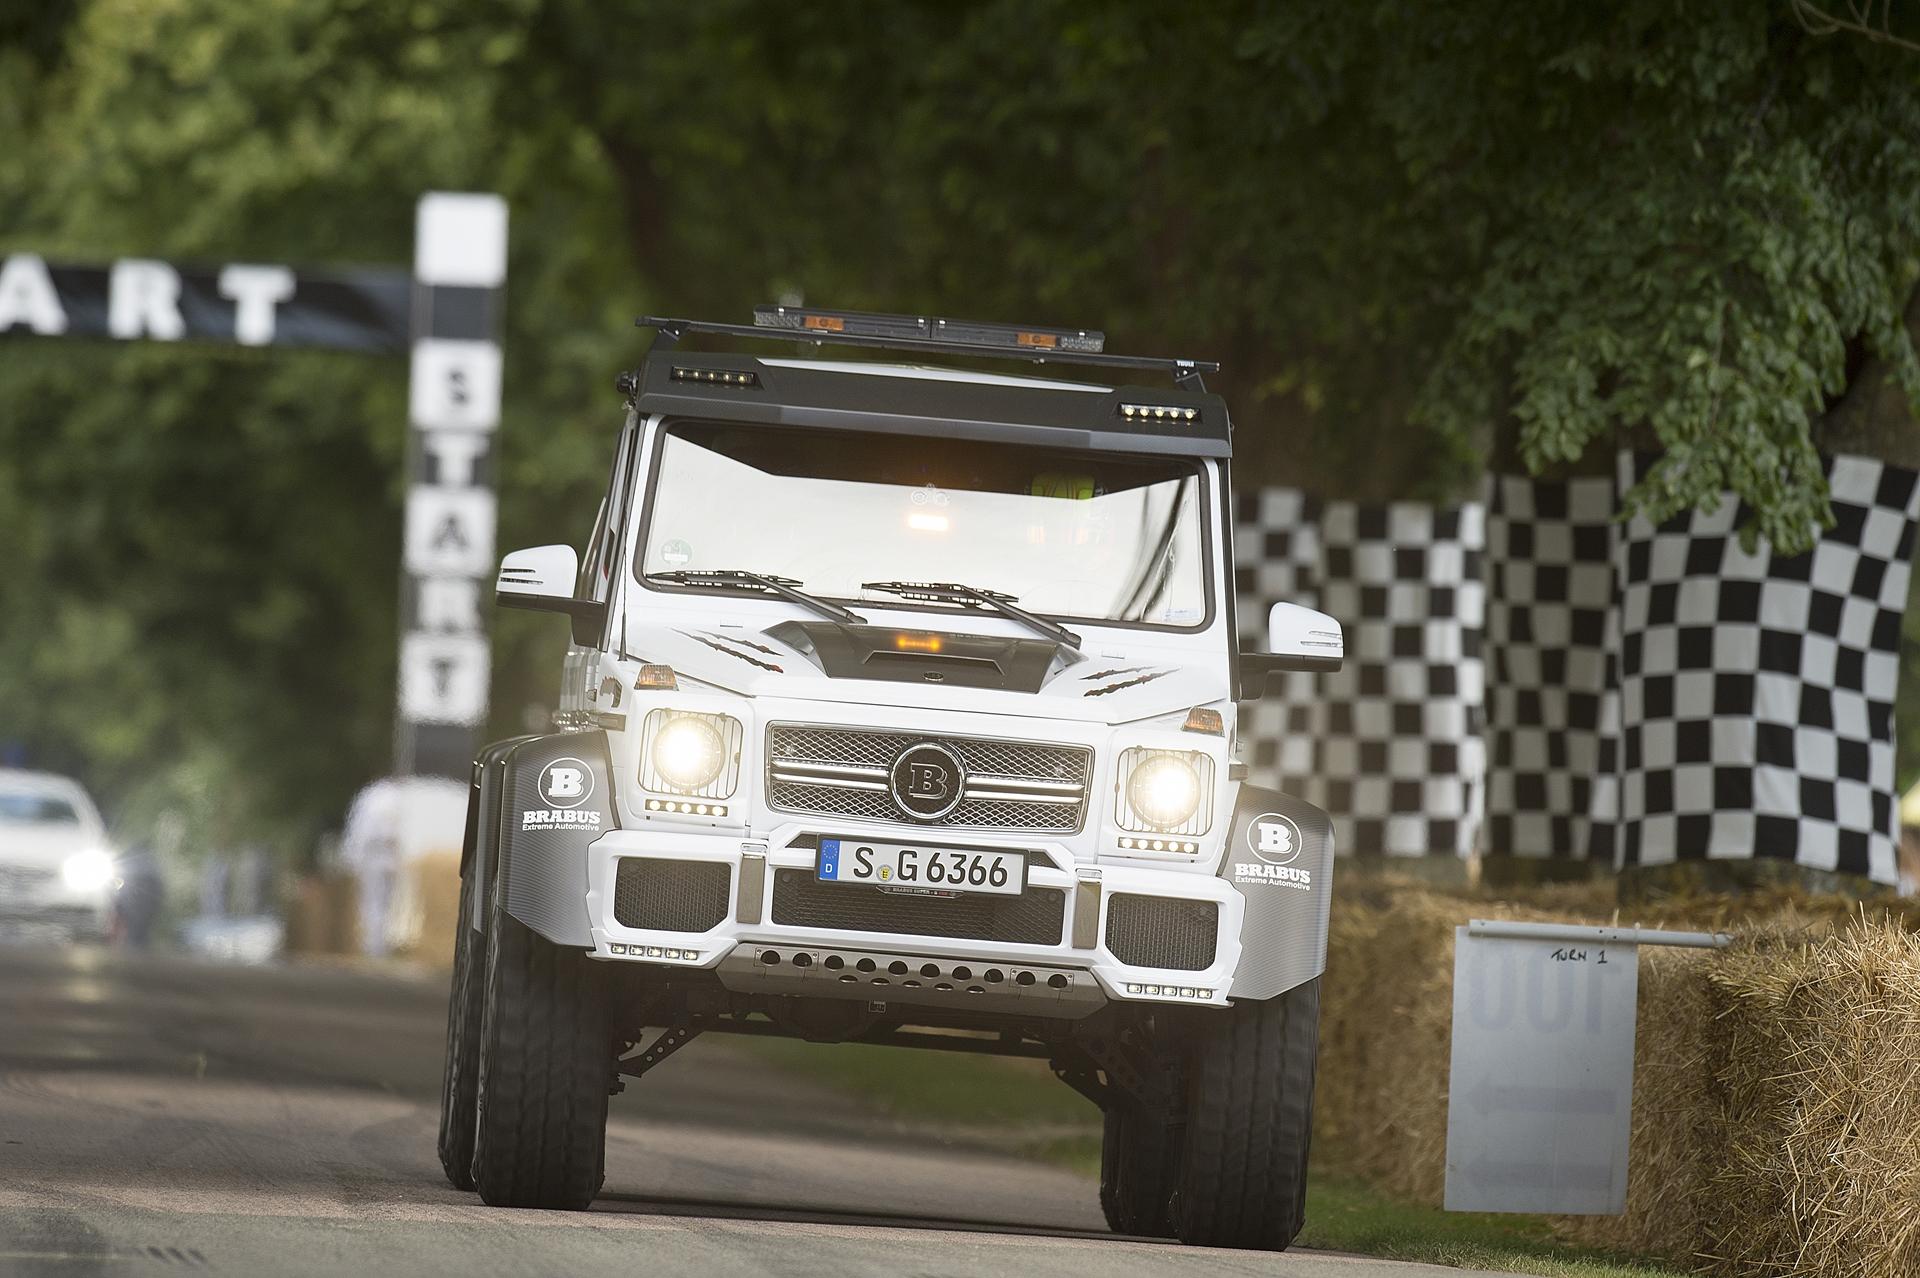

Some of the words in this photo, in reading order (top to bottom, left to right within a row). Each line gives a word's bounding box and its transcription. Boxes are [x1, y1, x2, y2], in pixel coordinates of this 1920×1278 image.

[548, 768, 584, 797] B
[908, 762, 947, 799] B
[522, 810, 600, 824] BRABUS
[522, 823, 553, 831] Extreme
[555, 823, 600, 831] Automotive
[1258, 822, 1293, 854] B
[825, 863, 832, 873] D
[1234, 863, 1311, 884] BRABUS
[1235, 876, 1267, 885] Extreme
[1268, 878, 1311, 891] Automotive
[1551, 949, 1587, 962] TURN
[1597, 950, 1608, 964] 1
